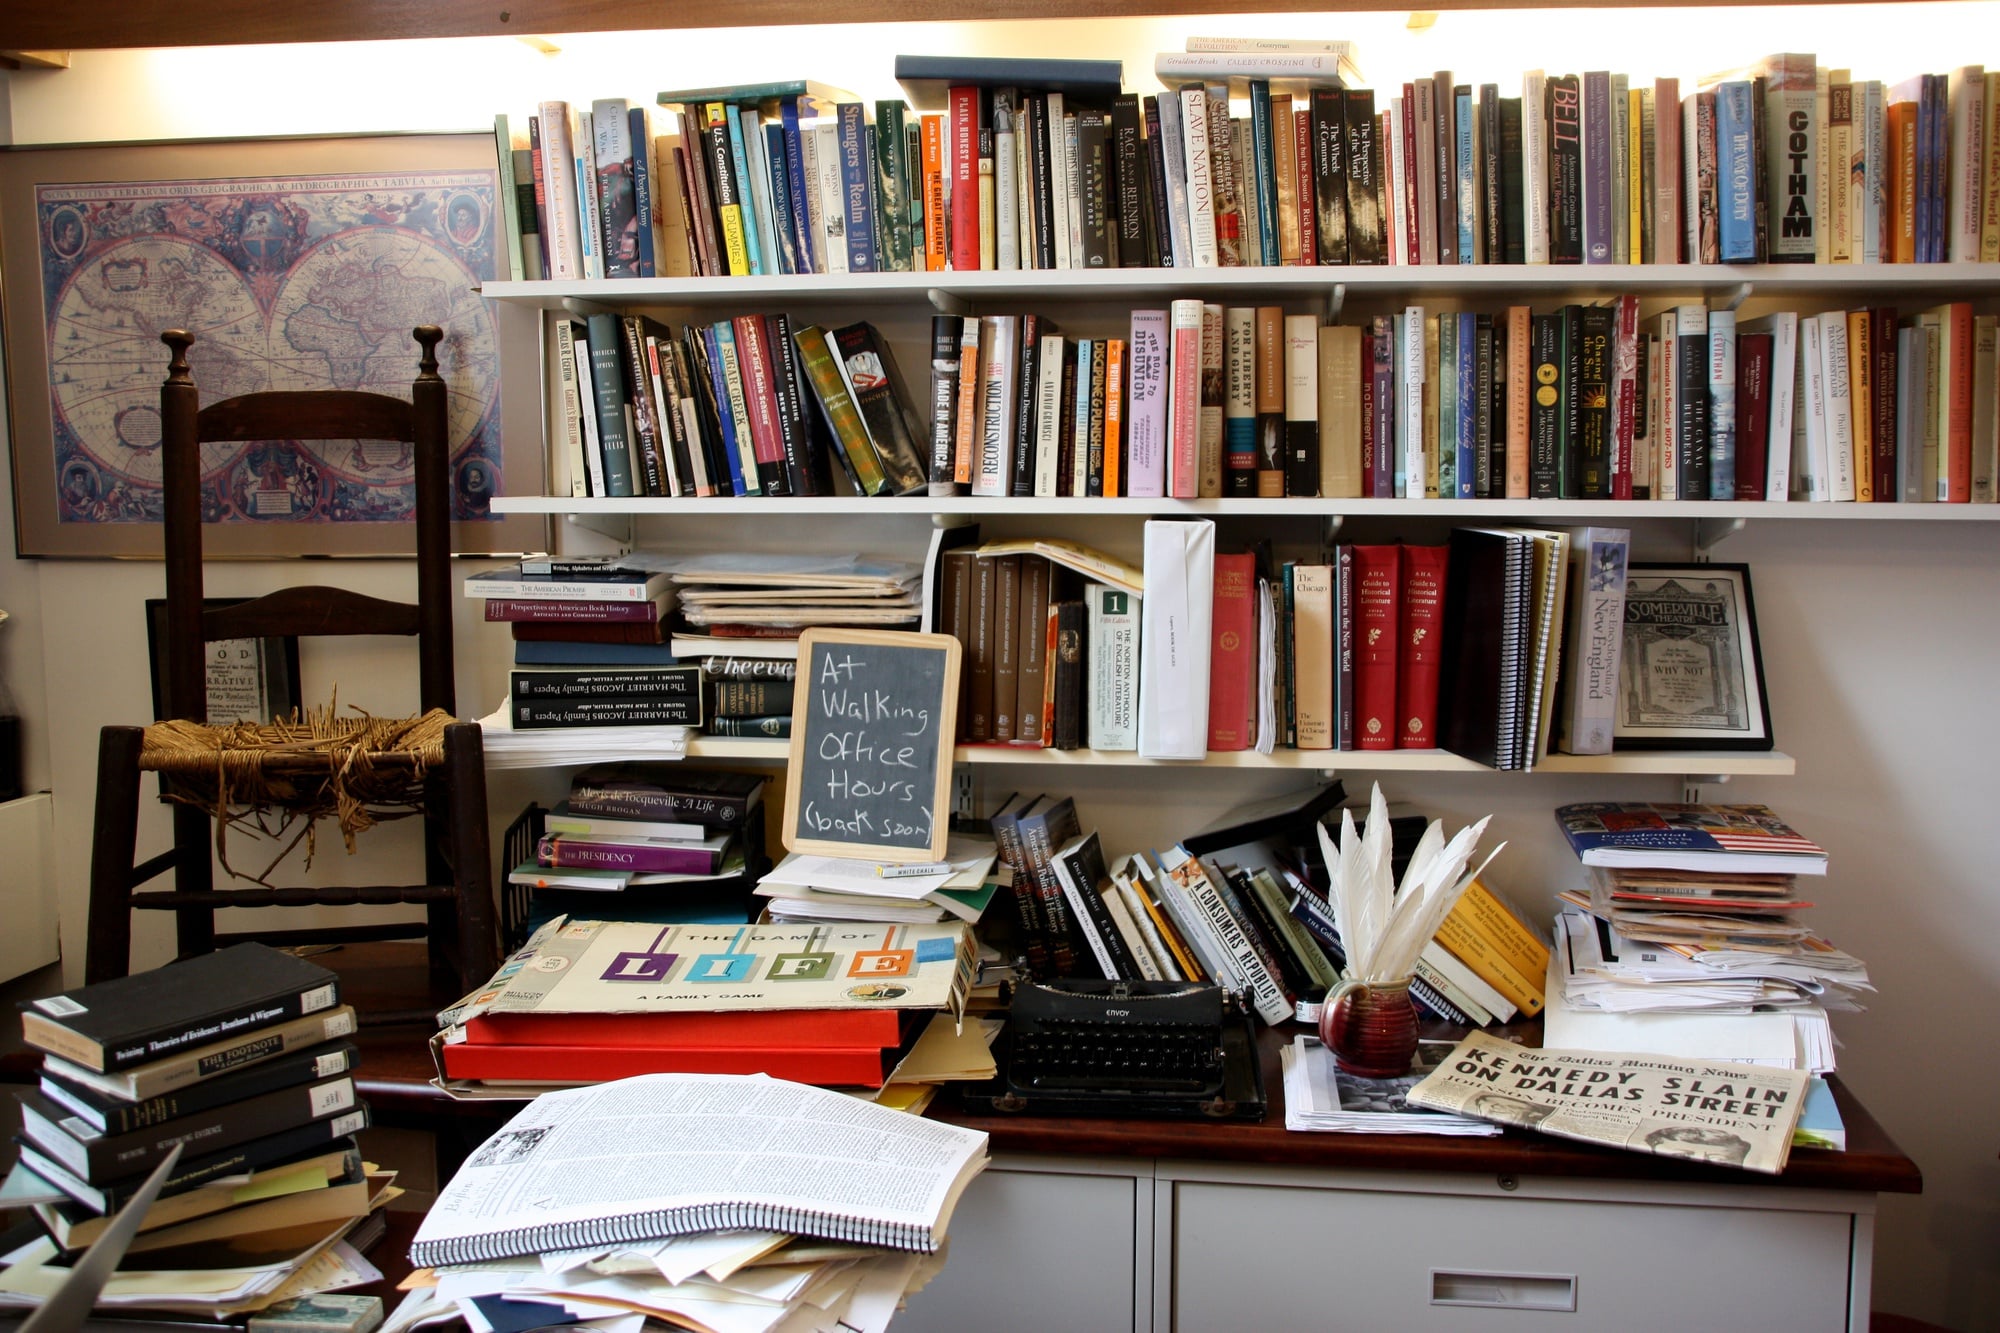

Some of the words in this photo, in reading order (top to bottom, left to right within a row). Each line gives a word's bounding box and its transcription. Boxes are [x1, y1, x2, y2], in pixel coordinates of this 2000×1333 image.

[959, 97, 969, 125] PLAIN,
[1188, 94, 1205, 144] SLAVE
[1321, 121, 1326, 129] of
[1552, 80, 1580, 150] BELL
[1873, 106, 1881, 130] AFTER
[713, 128, 723, 146] U.S.
[844, 106, 861, 168] Strangers
[960, 127, 968, 160] HONEST
[1124, 127, 1135, 158] RACE
[1331, 124, 1339, 141] The
[1734, 132, 1748, 151] THE
[1301, 160, 1309, 171] the
[1321, 131, 1329, 176] Commerce
[1331, 142, 1340, 173] Wheels
[1735, 154, 1749, 175] WAY
[716, 148, 731, 204] Constitution
[961, 163, 969, 180] MEN
[1086, 164, 1092, 174] IN
[1193, 150, 1209, 214] NATION
[1735, 176, 1749, 189] OF
[1783, 111, 1812, 238] GOTHAM
[850, 183, 865, 223] Realm
[1094, 145, 1103, 240] SLAVERY
[1734, 192, 1749, 221] DUTY
[1127, 187, 1139, 239] REUNION
[1303, 208, 1311, 227] Rick
[604, 202, 613, 256] ANDERSON
[726, 214, 741, 265] DUMMIES
[1303, 230, 1312, 254] Bragg
[1148, 333, 1158, 352] THE
[1203, 312, 1212, 365] CRISIS
[1231, 328, 1239, 354] AND
[1479, 336, 1488, 358] THE
[1584, 337, 1592, 354] the
[1134, 330, 1145, 401] DISUNION
[1584, 357, 1593, 379] Sun
[1594, 336, 1605, 380] Chasing
[723, 349, 738, 385] SUGAR
[731, 387, 746, 426] CREEK
[1024, 360, 1032, 397] American
[1109, 363, 1119, 392] WRITING
[1148, 385, 1156, 396] TO
[1231, 359, 1239, 400] GLORY
[1243, 351, 1251, 408] LIBERTY
[1365, 383, 1372, 392] In
[1479, 361, 1487, 411] CULTURE
[937, 380, 949, 408] MADE
[937, 410, 949, 421] IN
[1021, 399, 1030, 435] Discovery
[1109, 399, 1118, 421] STORY
[1364, 403, 1372, 440] Different
[1479, 416, 1487, 428] OF
[982, 380, 1002, 475] RECONSTRUCTION
[935, 423, 948, 467] AMERICA
[1019, 443, 1027, 471] Europe
[1364, 443, 1372, 468] Voice
[1479, 433, 1487, 484] LITERACY
[1695, 429, 1703, 469] CANAL
[1297, 584, 1327, 592] Chicago
[511, 604, 550, 612] Perspectives
[606, 605, 630, 613] History
[1111, 595, 1119, 611] 1
[1595, 598, 1608, 632] New
[1610, 598, 1619, 618] The
[1627, 601, 1724, 624] SOMERVILLE
[1116, 631, 1122, 642] OF
[707, 657, 796, 676] Cheeve
[1605, 620, 1618, 685] Encyclopedia
[821, 652, 866, 684] At
[1587, 636, 1606, 699] England
[1654, 666, 1678, 675] WHY
[1684, 667, 1704, 676] NOT
[534, 686, 561, 694] Papers
[563, 685, 589, 694] Family
[592, 684, 625, 692] JACOBS
[627, 683, 668, 691] HARRIET
[670, 683, 686, 691] The
[1603, 686, 1613, 697] of
[822, 689, 928, 736] Walking
[1123, 682, 1131, 730] ANTHOLOGY
[820, 731, 918, 768] Office
[579, 786, 608, 799] Alexis
[610, 790, 623, 799] de
[623, 791, 679, 808] Tocqueville
[683, 798, 695, 808] A
[696, 799, 715, 812] Life
[827, 769, 915, 801] Hours
[805, 801, 874, 835] (back
[880, 806, 933, 845] soon)
[578, 852, 634, 863] PRESIDENCY
[1027, 828, 1042, 868] American
[1036, 868, 1052, 902] Political
[1044, 903, 1060, 934] History
[1195, 881, 1203, 892] A
[1201, 891, 1248, 950] CONSUMERS'
[1238, 952, 1277, 1000] REPUBLIC
[1416, 963, 1428, 975] WE
[1428, 973, 1449, 992] VOTE
[203, 1056, 224, 1067] THE
[226, 1037, 280, 1058] FOOTNOTE
[1455, 1061, 1501, 1082] ON
[1515, 1078, 1644, 1101] DALLAS
[1661, 1093, 1782, 1118] STREET
[1465, 1048, 1637, 1084] KENNEDY
[1663, 1078, 1788, 1102] SLAIN
[1443, 1075, 1533, 1101] JOHNSON
[1545, 1098, 1642, 1116] BECOMES
[1653, 1109, 1776, 1131] PRESIDENT
